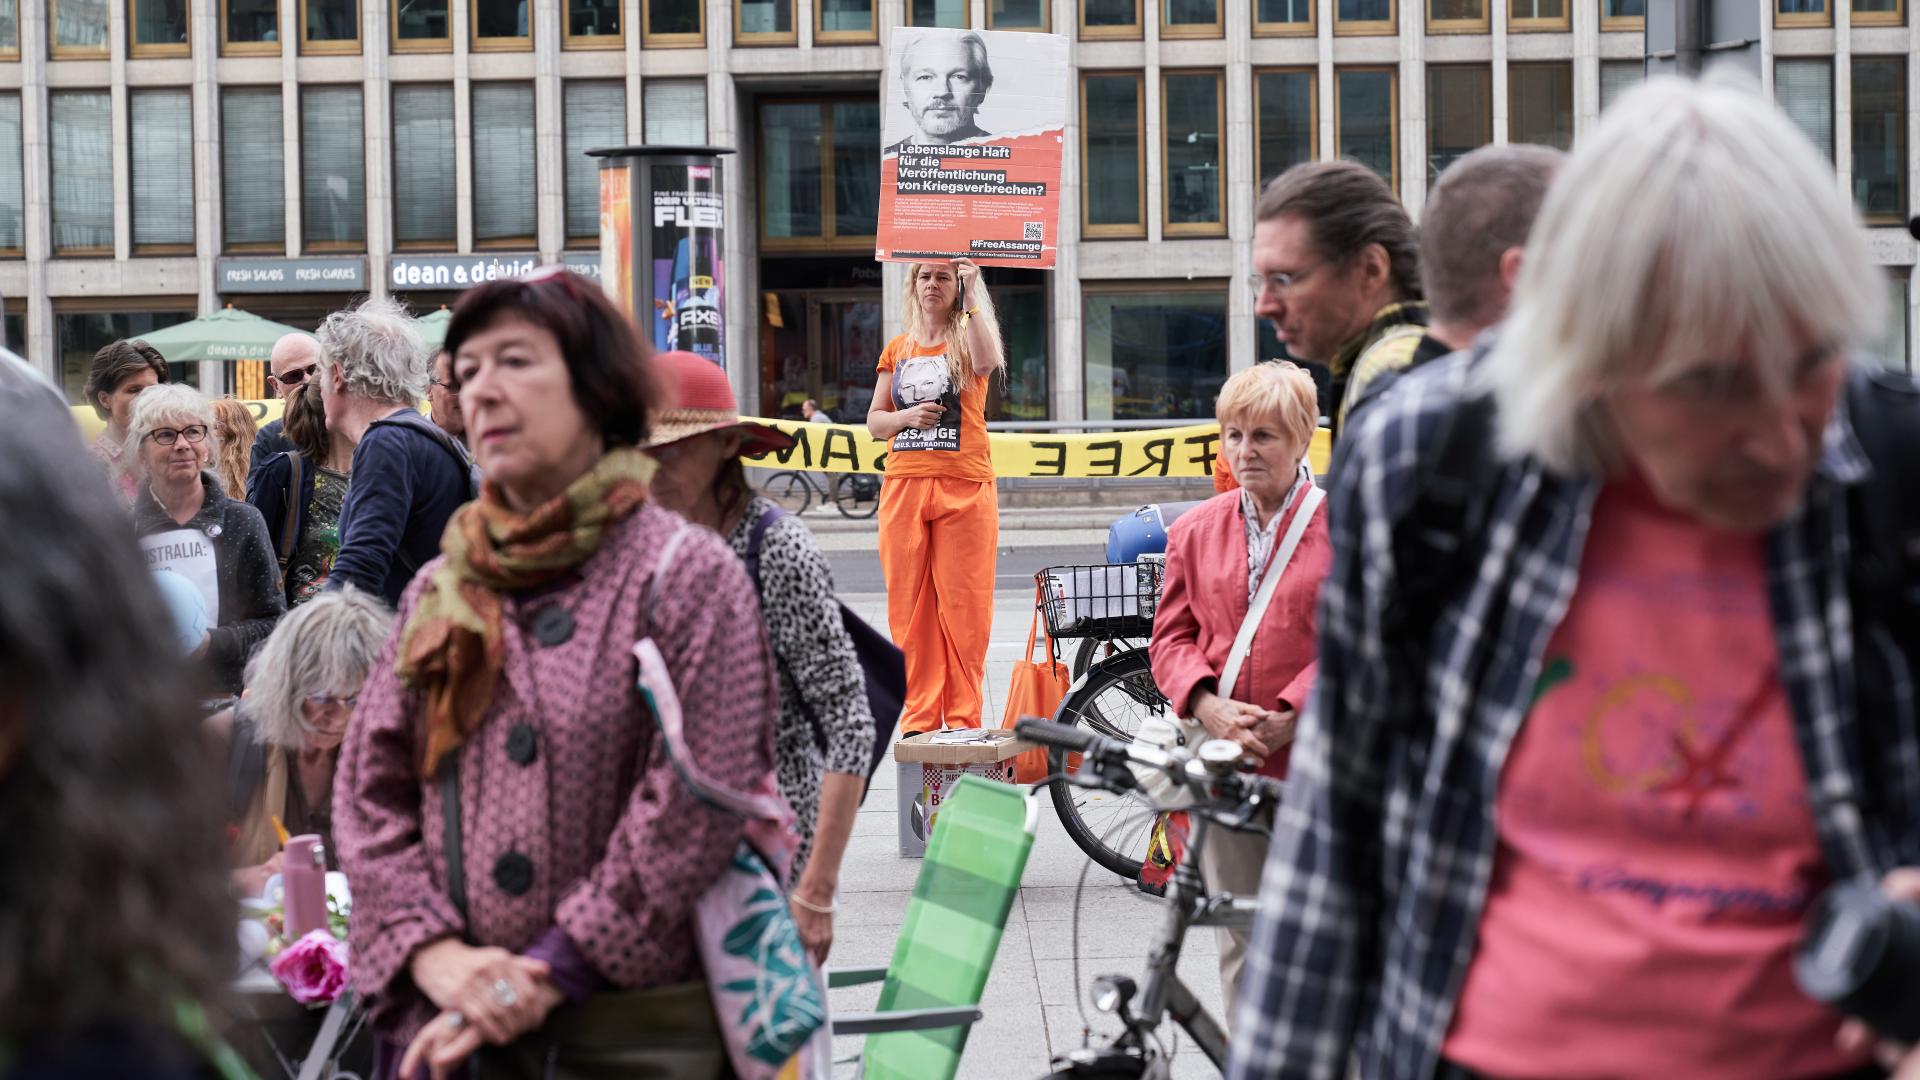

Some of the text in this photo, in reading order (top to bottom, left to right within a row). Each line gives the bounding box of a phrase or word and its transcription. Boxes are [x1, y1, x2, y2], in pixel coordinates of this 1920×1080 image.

[899, 143, 1010, 159] Lebenslange Haft
[898, 156, 940, 167] für die
[898, 168, 1006, 184] Veröffentlichung
[897, 181, 1045, 196] von Kriegsverbrechen?
[654, 197, 681, 206] DER
[971, 240, 1041, 252] #FreeAssange
[227, 267, 356, 281] FRESH SALADS FRESH CURRIES
[393, 262, 450, 284] dean
[453, 264, 468, 284] &
[681, 310, 719, 326] AXE
[207, 344, 237, 356] dean
[900, 441, 911, 449] U.S.
